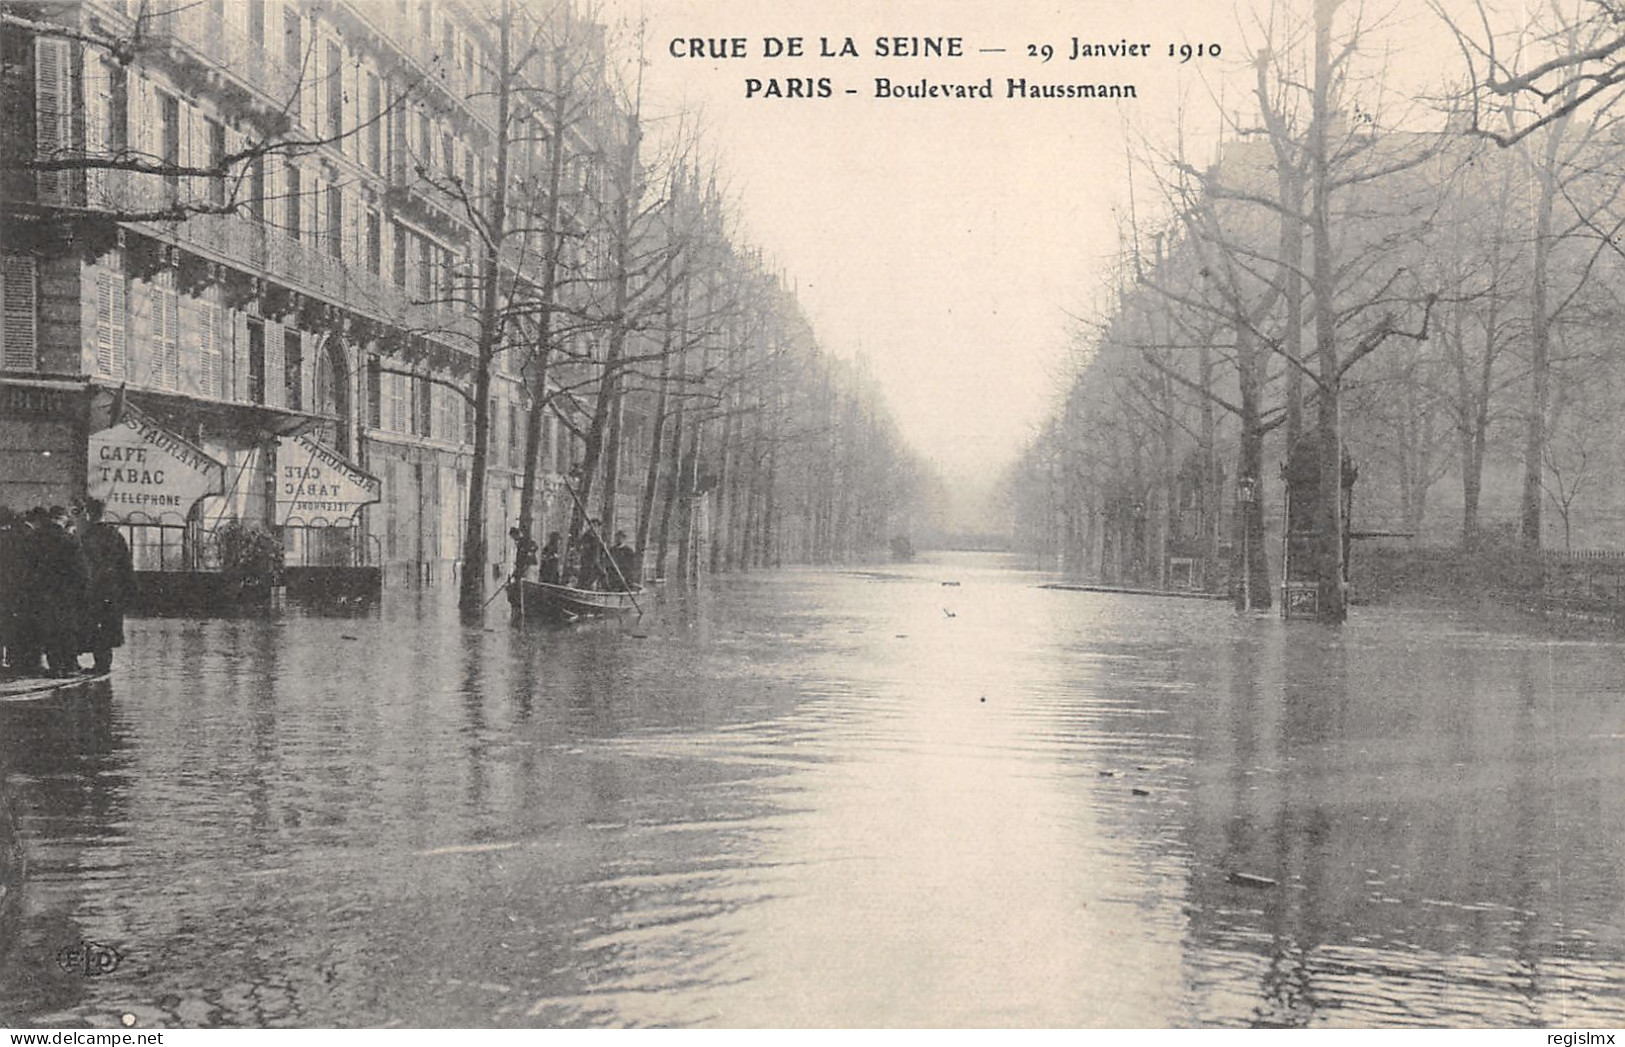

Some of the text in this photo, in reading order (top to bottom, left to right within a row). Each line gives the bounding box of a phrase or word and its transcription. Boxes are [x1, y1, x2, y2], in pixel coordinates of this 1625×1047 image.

[121, 410, 212, 476] ESTAURANT
[99, 467, 165, 485] TABAC
[113, 493, 181, 506] TELEPHONE
